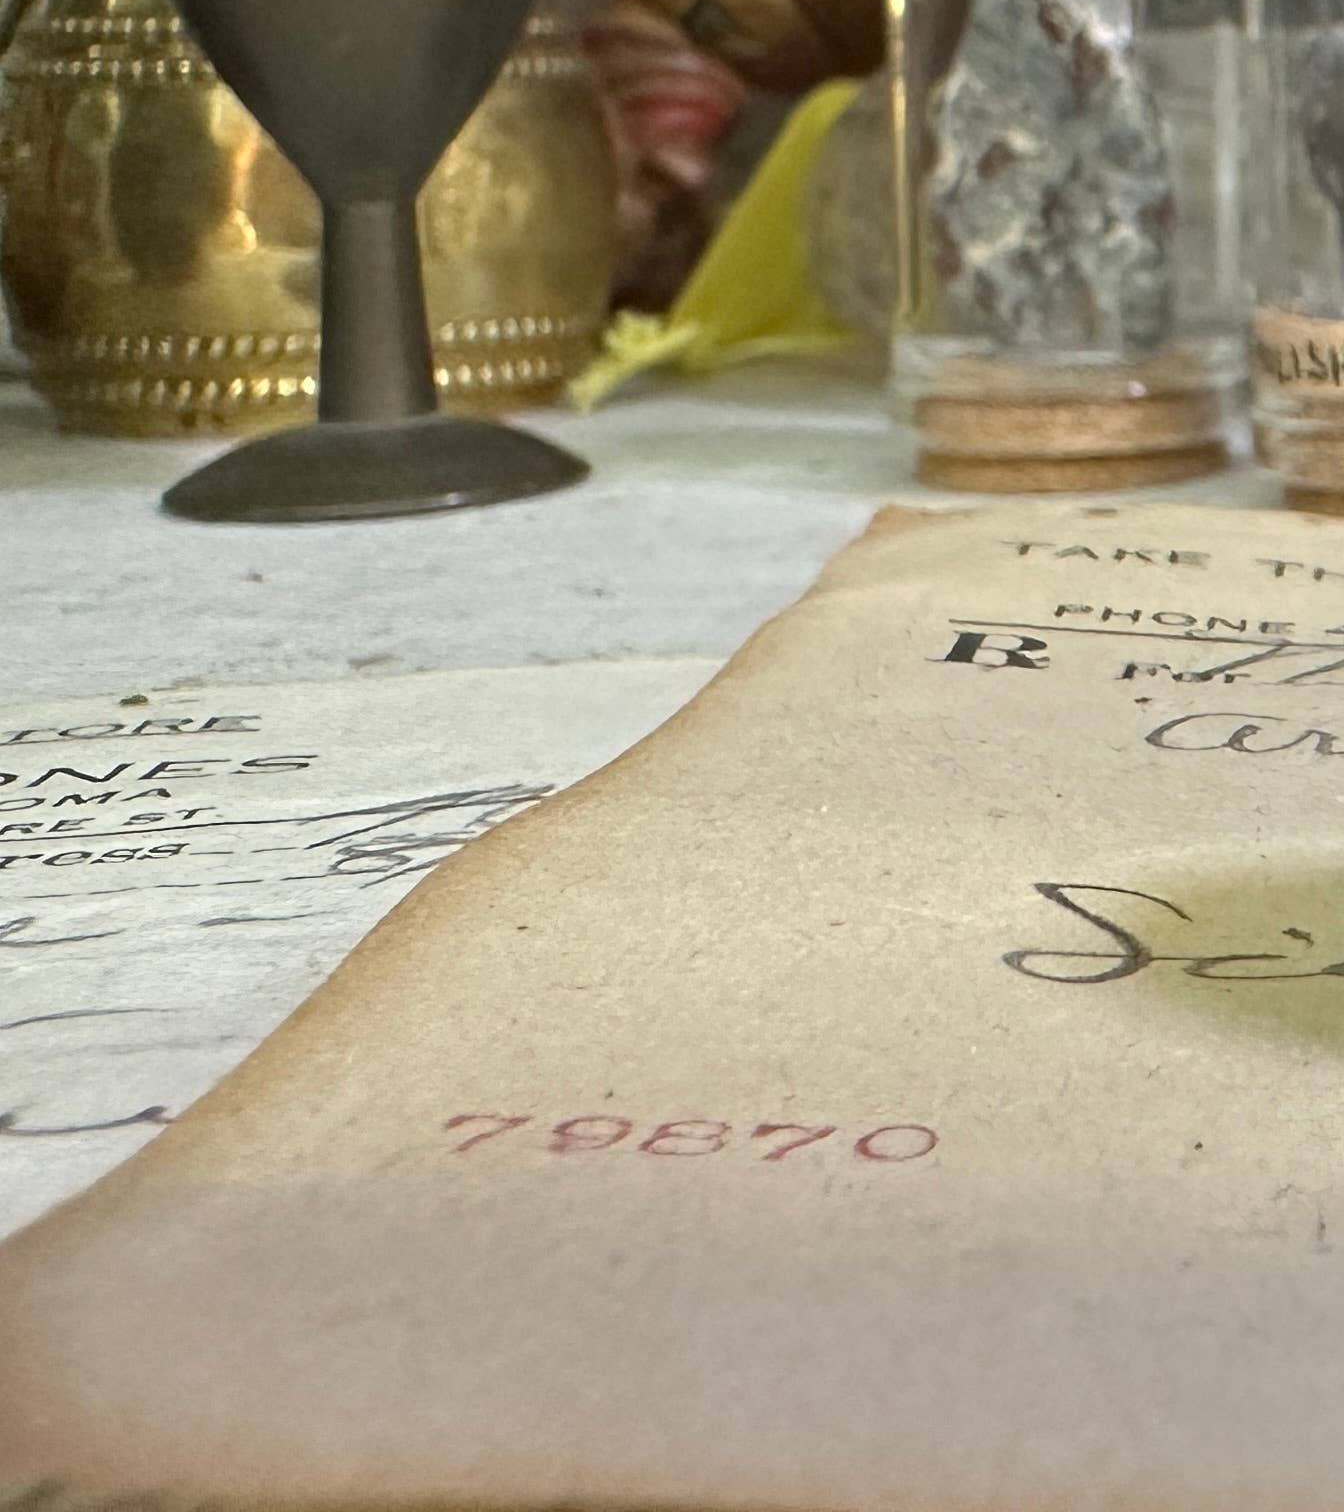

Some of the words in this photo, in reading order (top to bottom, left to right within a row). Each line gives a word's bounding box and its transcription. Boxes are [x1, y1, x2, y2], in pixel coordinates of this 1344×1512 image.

[1001, 540, 1212, 567] TAKE
[1051, 603, 1298, 633] PHONE
[442, 1113, 940, 1163] 79870
